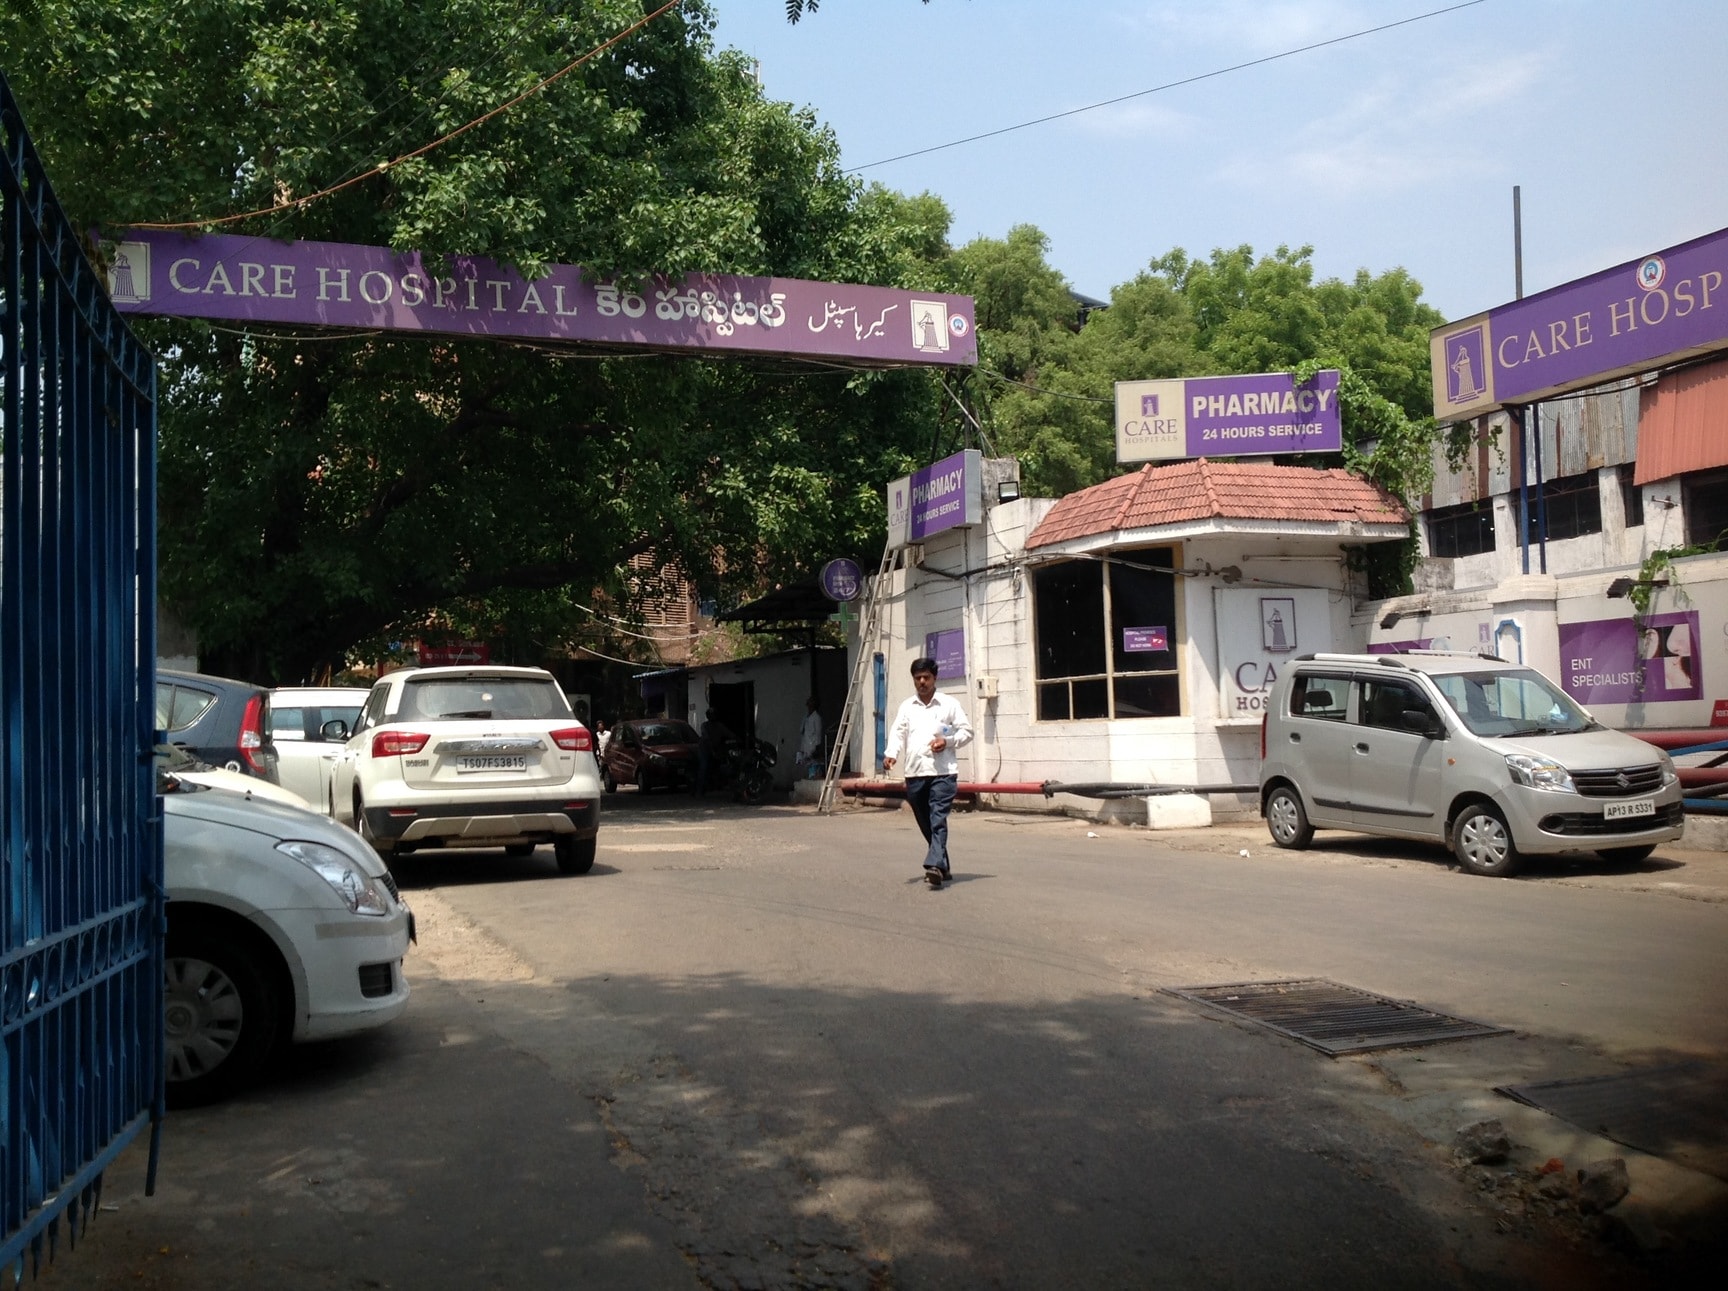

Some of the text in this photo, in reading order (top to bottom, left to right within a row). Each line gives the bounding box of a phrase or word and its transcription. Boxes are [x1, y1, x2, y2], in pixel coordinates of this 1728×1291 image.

[169, 258, 578, 316] CARE HOSPITAL
[1498, 271, 1722, 369] CARE HOSP
[1192, 389, 1332, 418] PHARMACY
[1124, 419, 1178, 436] CARE
[1202, 423, 1323, 440] 24 HOURS SERVICE
[1125, 435, 1178, 444] HOSPITALS
[913, 468, 963, 506] PHARMACY
[939, 499, 960, 515] SERVICE
[1571, 658, 1593, 670] ENT
[1572, 671, 1643, 688] SPECIALISTS
[463, 757, 524, 768] TS07FS3815
[1607, 803, 1653, 817] AP13 R 5331
